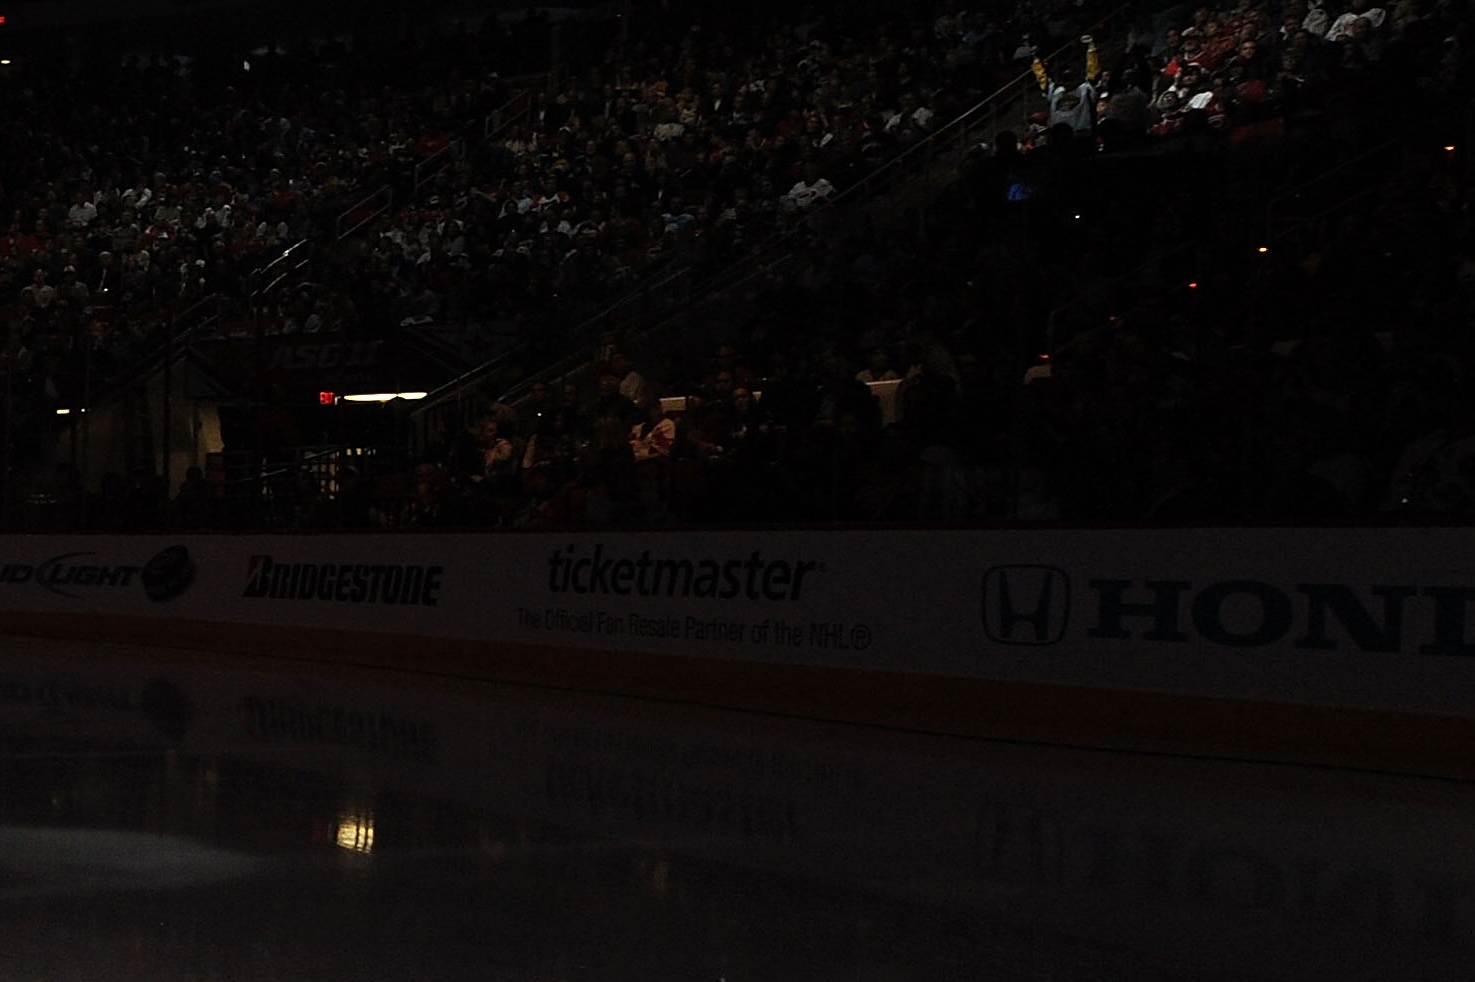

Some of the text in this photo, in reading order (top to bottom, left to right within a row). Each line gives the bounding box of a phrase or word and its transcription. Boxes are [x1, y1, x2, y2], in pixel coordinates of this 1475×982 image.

[48, 563, 142, 586] LIGHT
[242, 555, 443, 606] BRIDGESTONE
[549, 544, 816, 601] ticketmaster
[518, 608, 542, 627] The
[545, 609, 594, 633] Official
[597, 611, 625, 635] Fan
[629, 613, 680, 639] Resale
[684, 616, 746, 643] Partner
[752, 619, 772, 644] of
[774, 620, 804, 647] the
